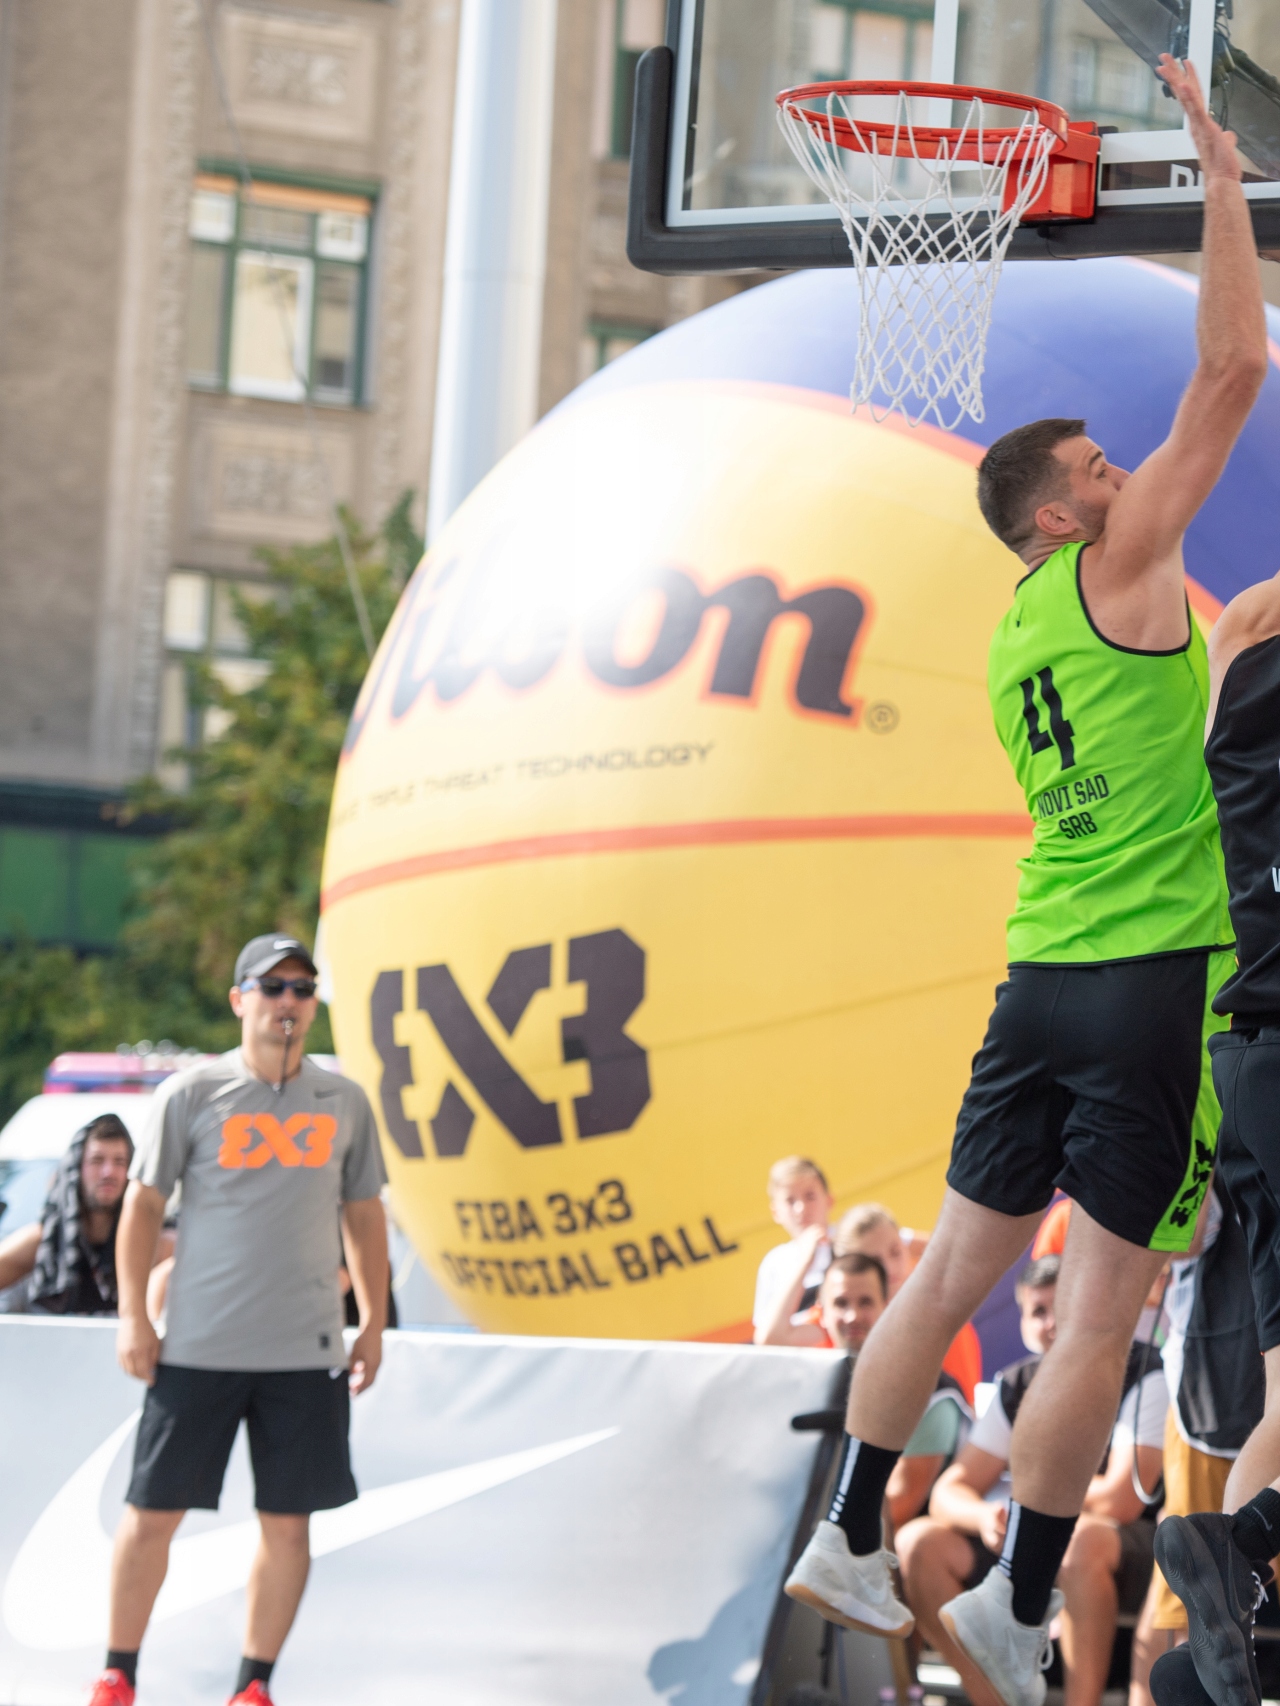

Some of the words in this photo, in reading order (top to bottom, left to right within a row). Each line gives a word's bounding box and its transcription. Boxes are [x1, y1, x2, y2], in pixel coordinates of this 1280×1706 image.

[1019, 666, 1076, 771] 4
[516, 741, 715, 779] TECHNOLOGY
[1074, 773, 1110, 806] SAD
[1059, 811, 1097, 840] SRB
[455, 1199, 544, 1242] FIBA
[547, 1178, 633, 1236] 3x3
[442, 1249, 610, 1297] OFFICIAL
[613, 1216, 738, 1282] BALL
